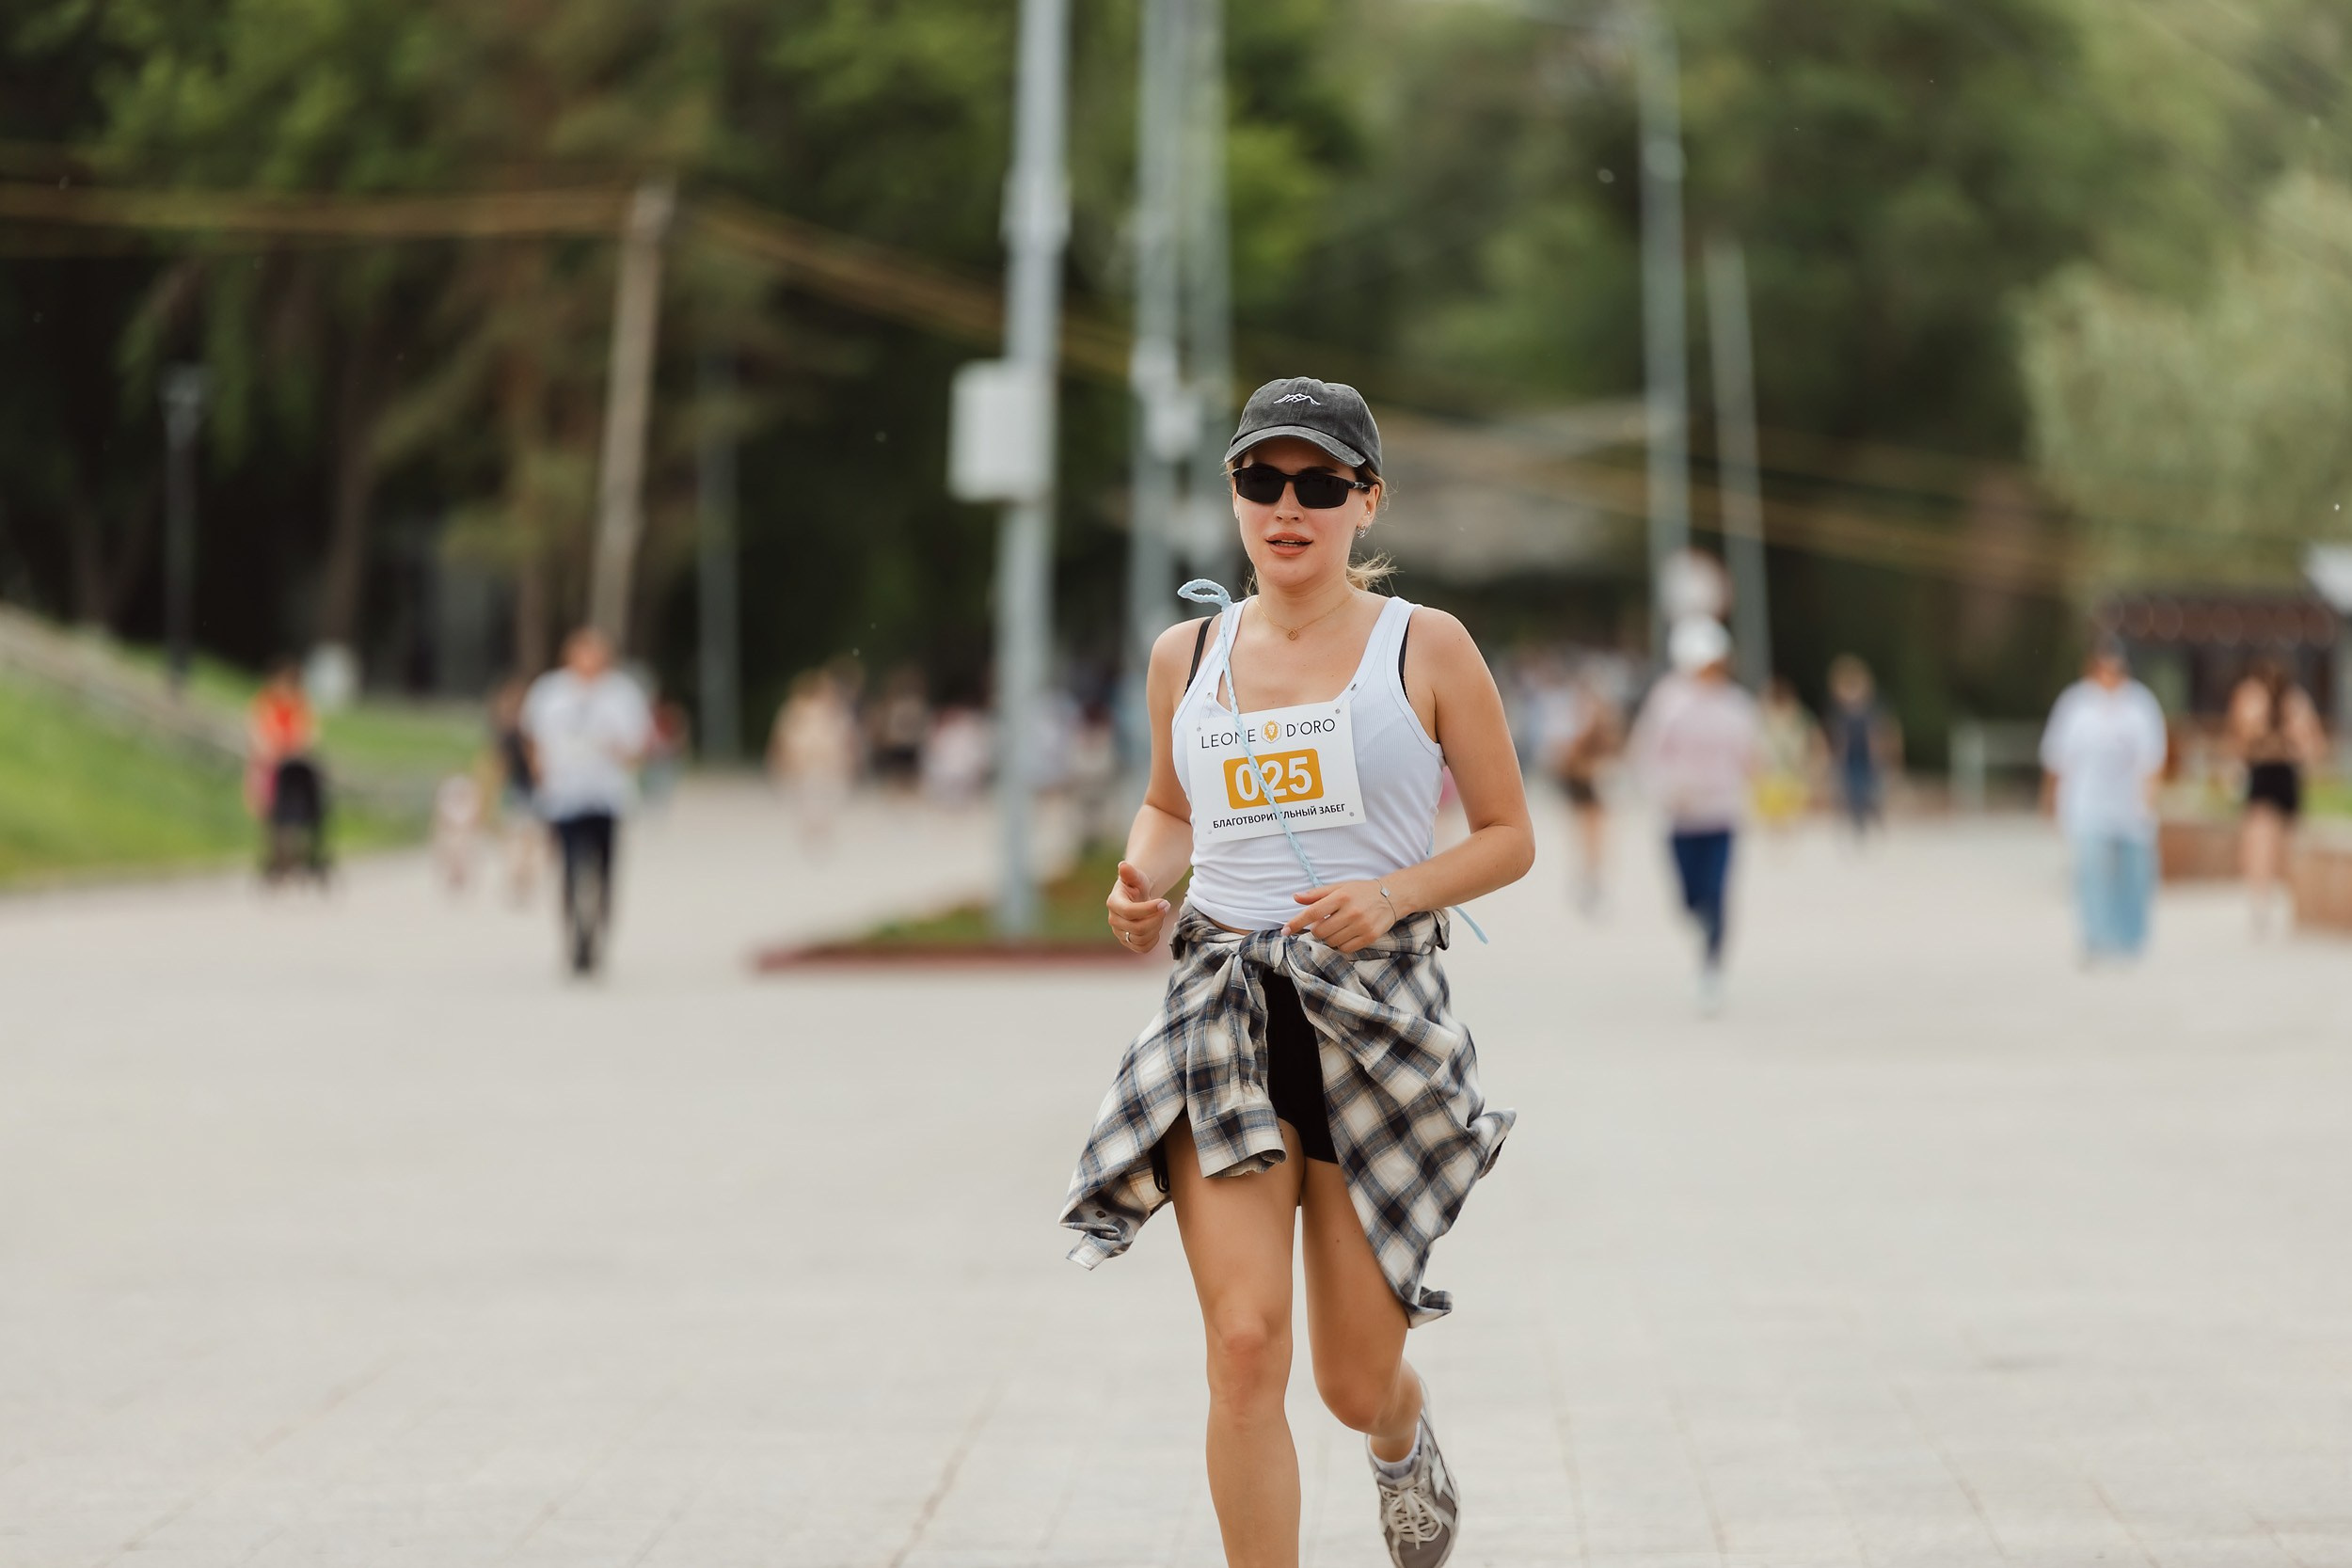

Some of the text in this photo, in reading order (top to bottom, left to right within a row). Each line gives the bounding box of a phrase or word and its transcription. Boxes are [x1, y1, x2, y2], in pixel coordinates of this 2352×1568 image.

[1286, 719, 1336, 737] D'ORO
[1235, 756, 1312, 801] 025
[1213, 803, 1345, 829] БЛАГОТВОРИТЛЬНЫЙ ЗАБЕГ
